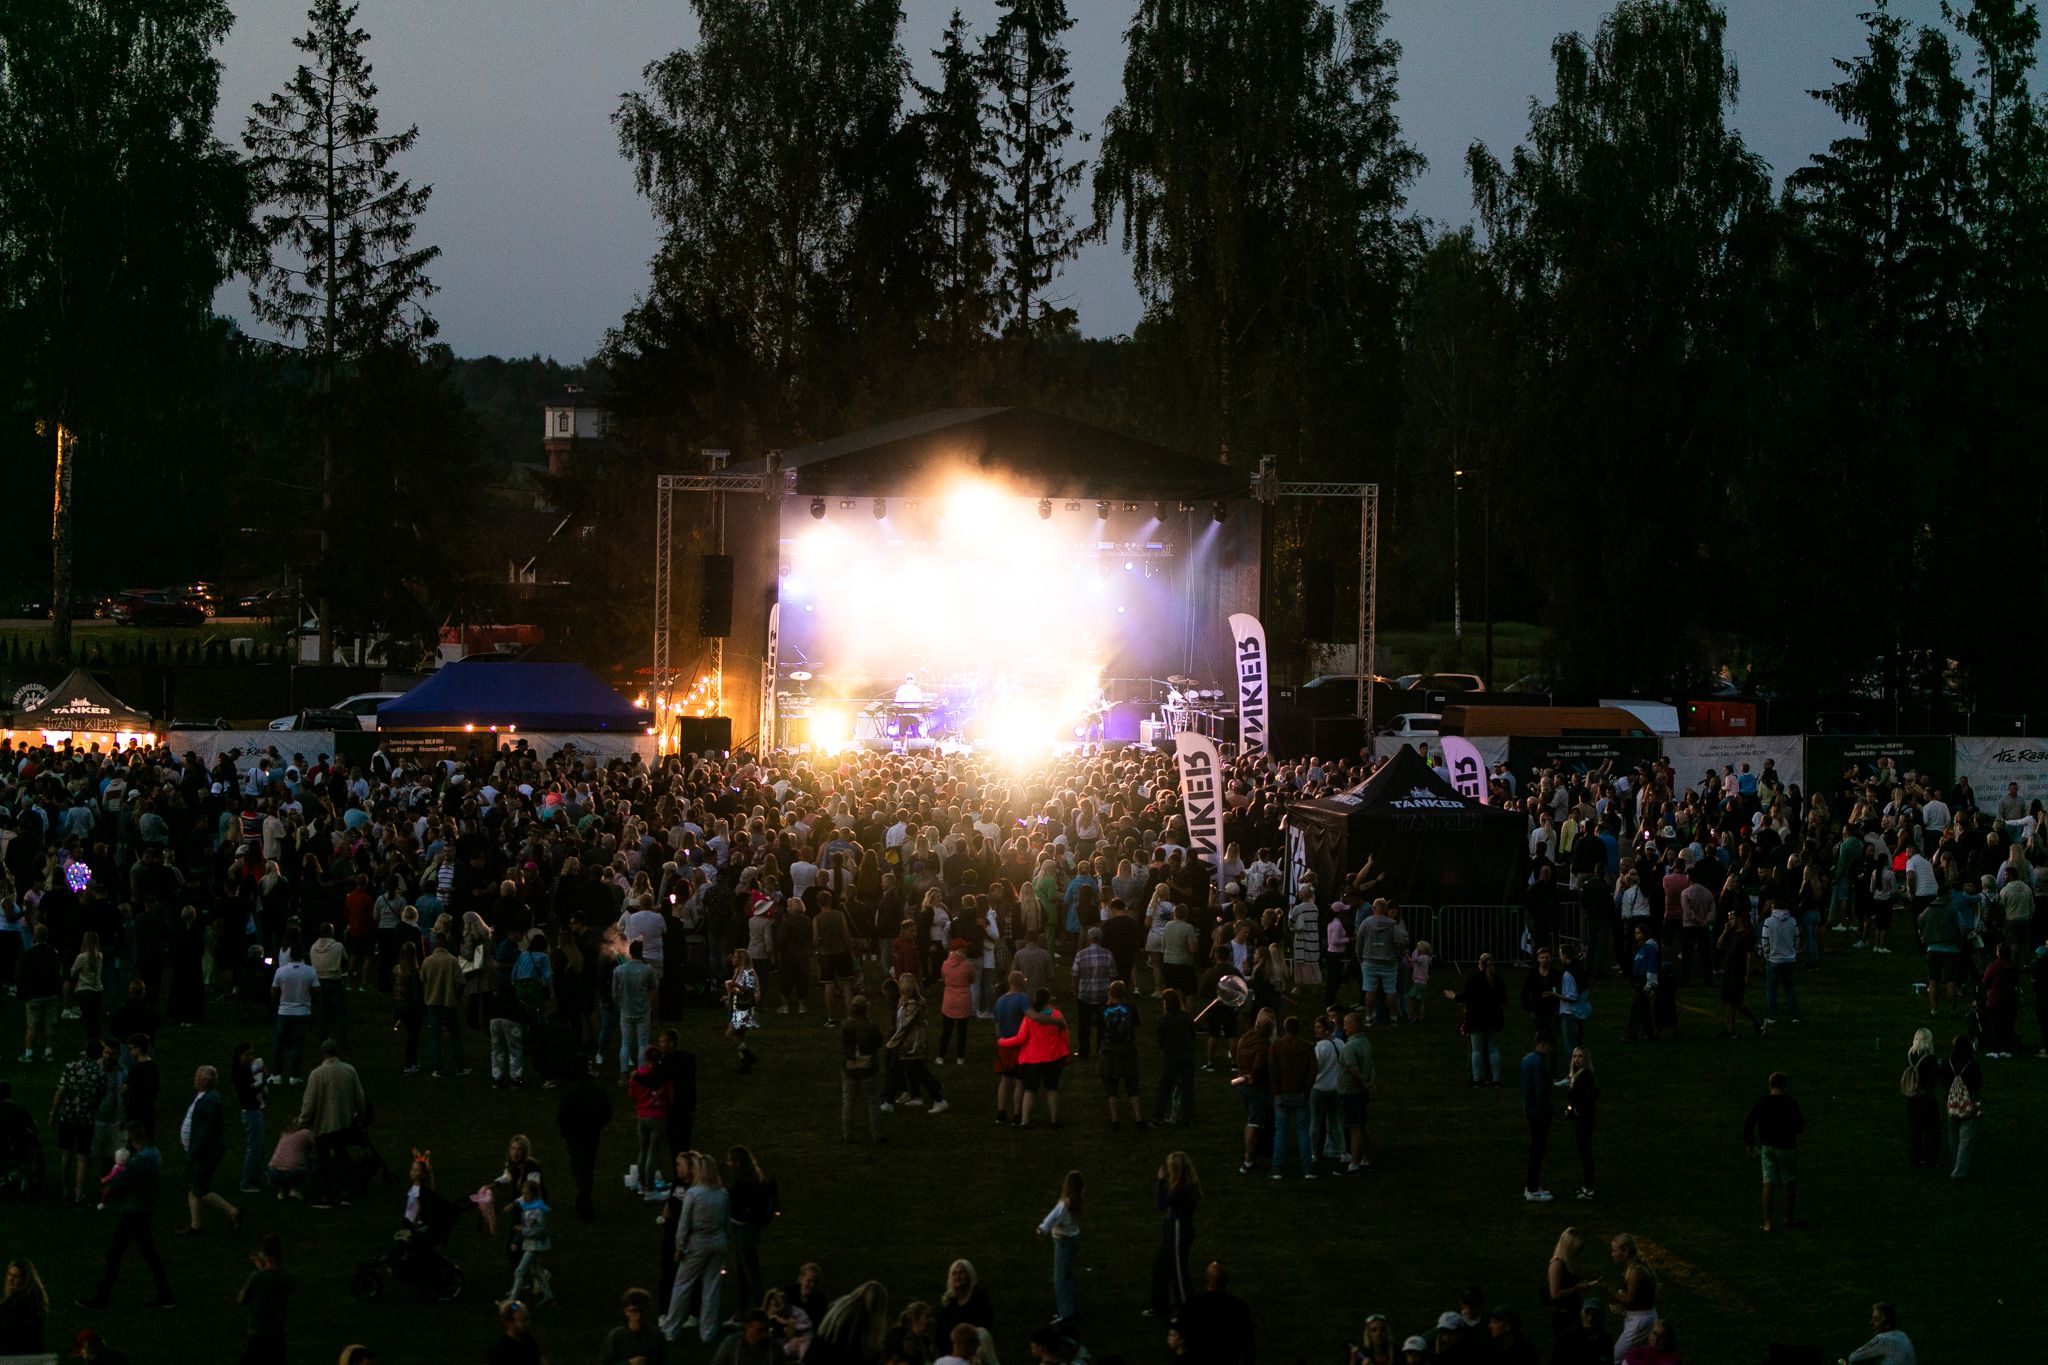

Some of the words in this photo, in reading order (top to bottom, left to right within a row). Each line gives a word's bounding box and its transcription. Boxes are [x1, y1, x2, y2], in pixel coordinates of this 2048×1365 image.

[44, 717, 118, 731] TANKER
[1390, 799, 1466, 808] TANKER
[1391, 813, 1483, 832] TANKER
